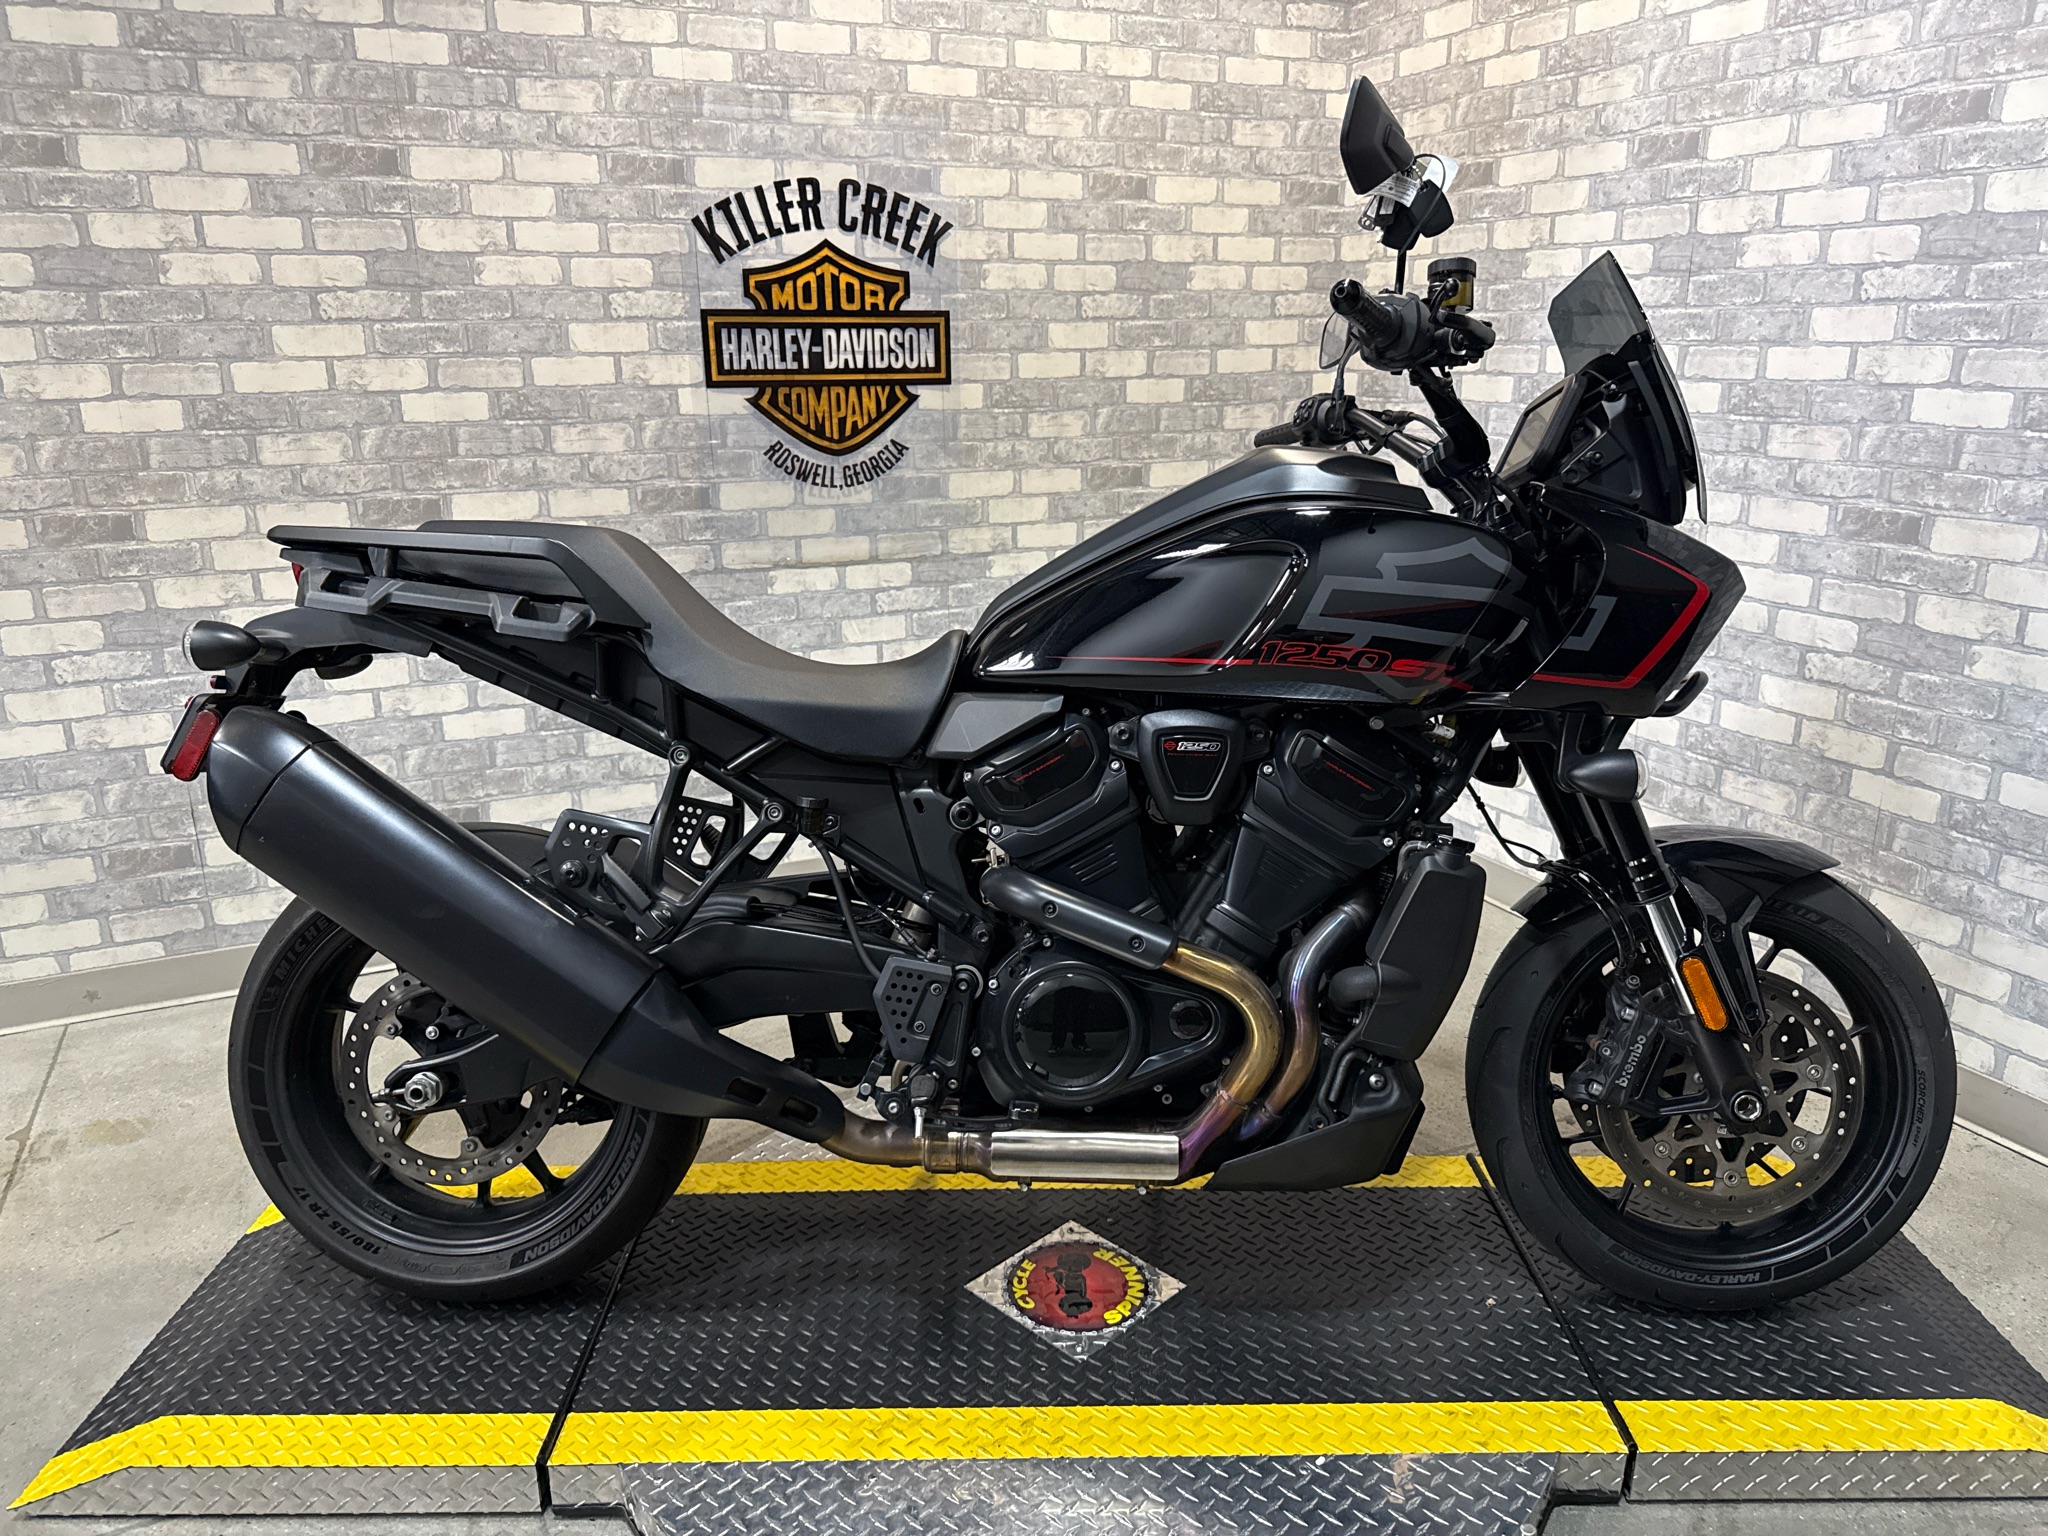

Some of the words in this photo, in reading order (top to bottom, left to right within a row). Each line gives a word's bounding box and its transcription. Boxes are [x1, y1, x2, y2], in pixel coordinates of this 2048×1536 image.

[691, 177, 825, 265] KILLER
[838, 178, 954, 268] CREEK
[771, 261, 885, 311] MOTOR
[720, 327, 935, 372] HARLEY-DAVIDSON
[777, 385, 890, 440] COMPANY
[1176, 741, 1221, 752] 1250
[1615, 1034, 1647, 1088] brembo
[1914, 1069, 1928, 1124] SCORCHER
[292, 1185, 312, 1202] 17
[308, 1201, 331, 1221] ZR
[522, 1132, 643, 1263] HARLEY-DAVIDSON
[328, 1219, 384, 1256] 180/55
[1011, 1259, 1037, 1310] CYCLE
[1092, 1248, 1146, 1325] SPINNER
[1619, 1250, 1760, 1285] HARLEY-DAVIDSON
